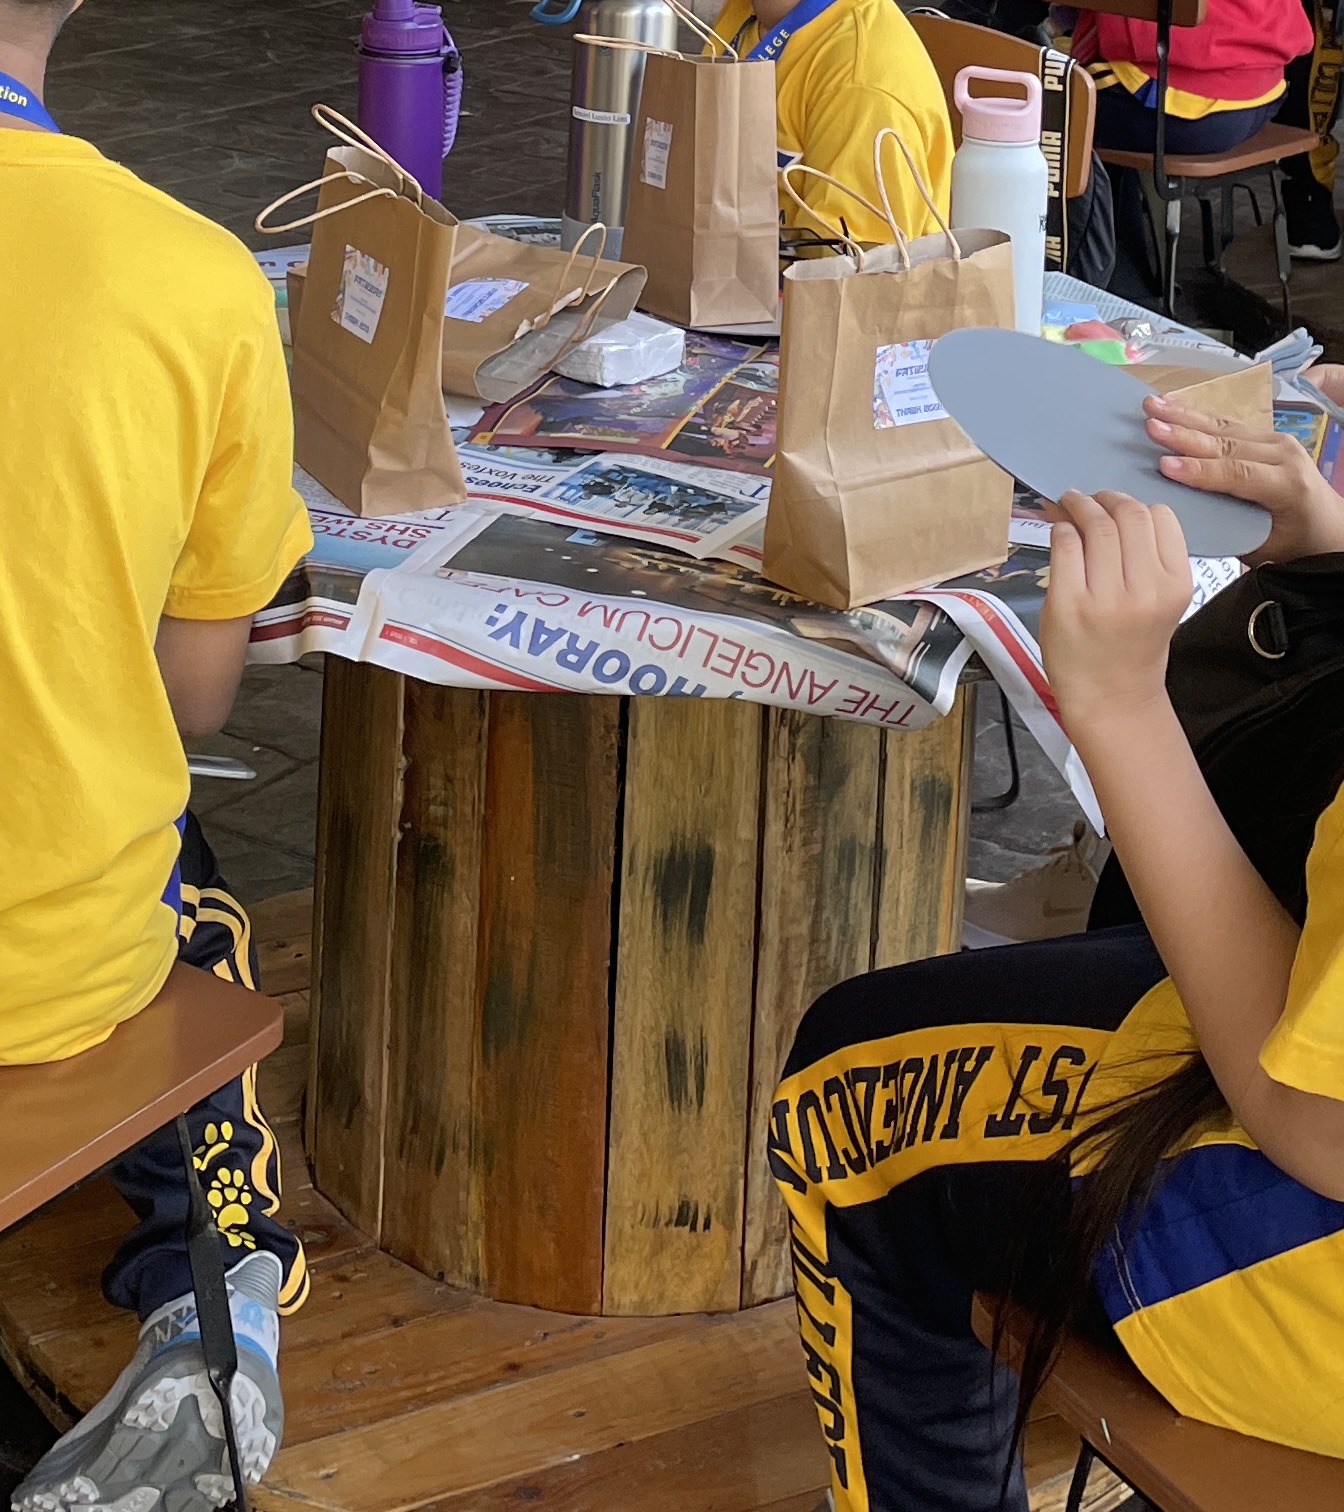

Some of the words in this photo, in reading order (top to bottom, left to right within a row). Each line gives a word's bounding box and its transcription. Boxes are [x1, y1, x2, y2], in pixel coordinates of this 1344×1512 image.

[464, 475, 542, 494] Echoes
[521, 473, 556, 484] The
[365, 521, 432, 539] SHS
[577, 599, 838, 706] ANGELICUM
[835, 683, 917, 728] THE
